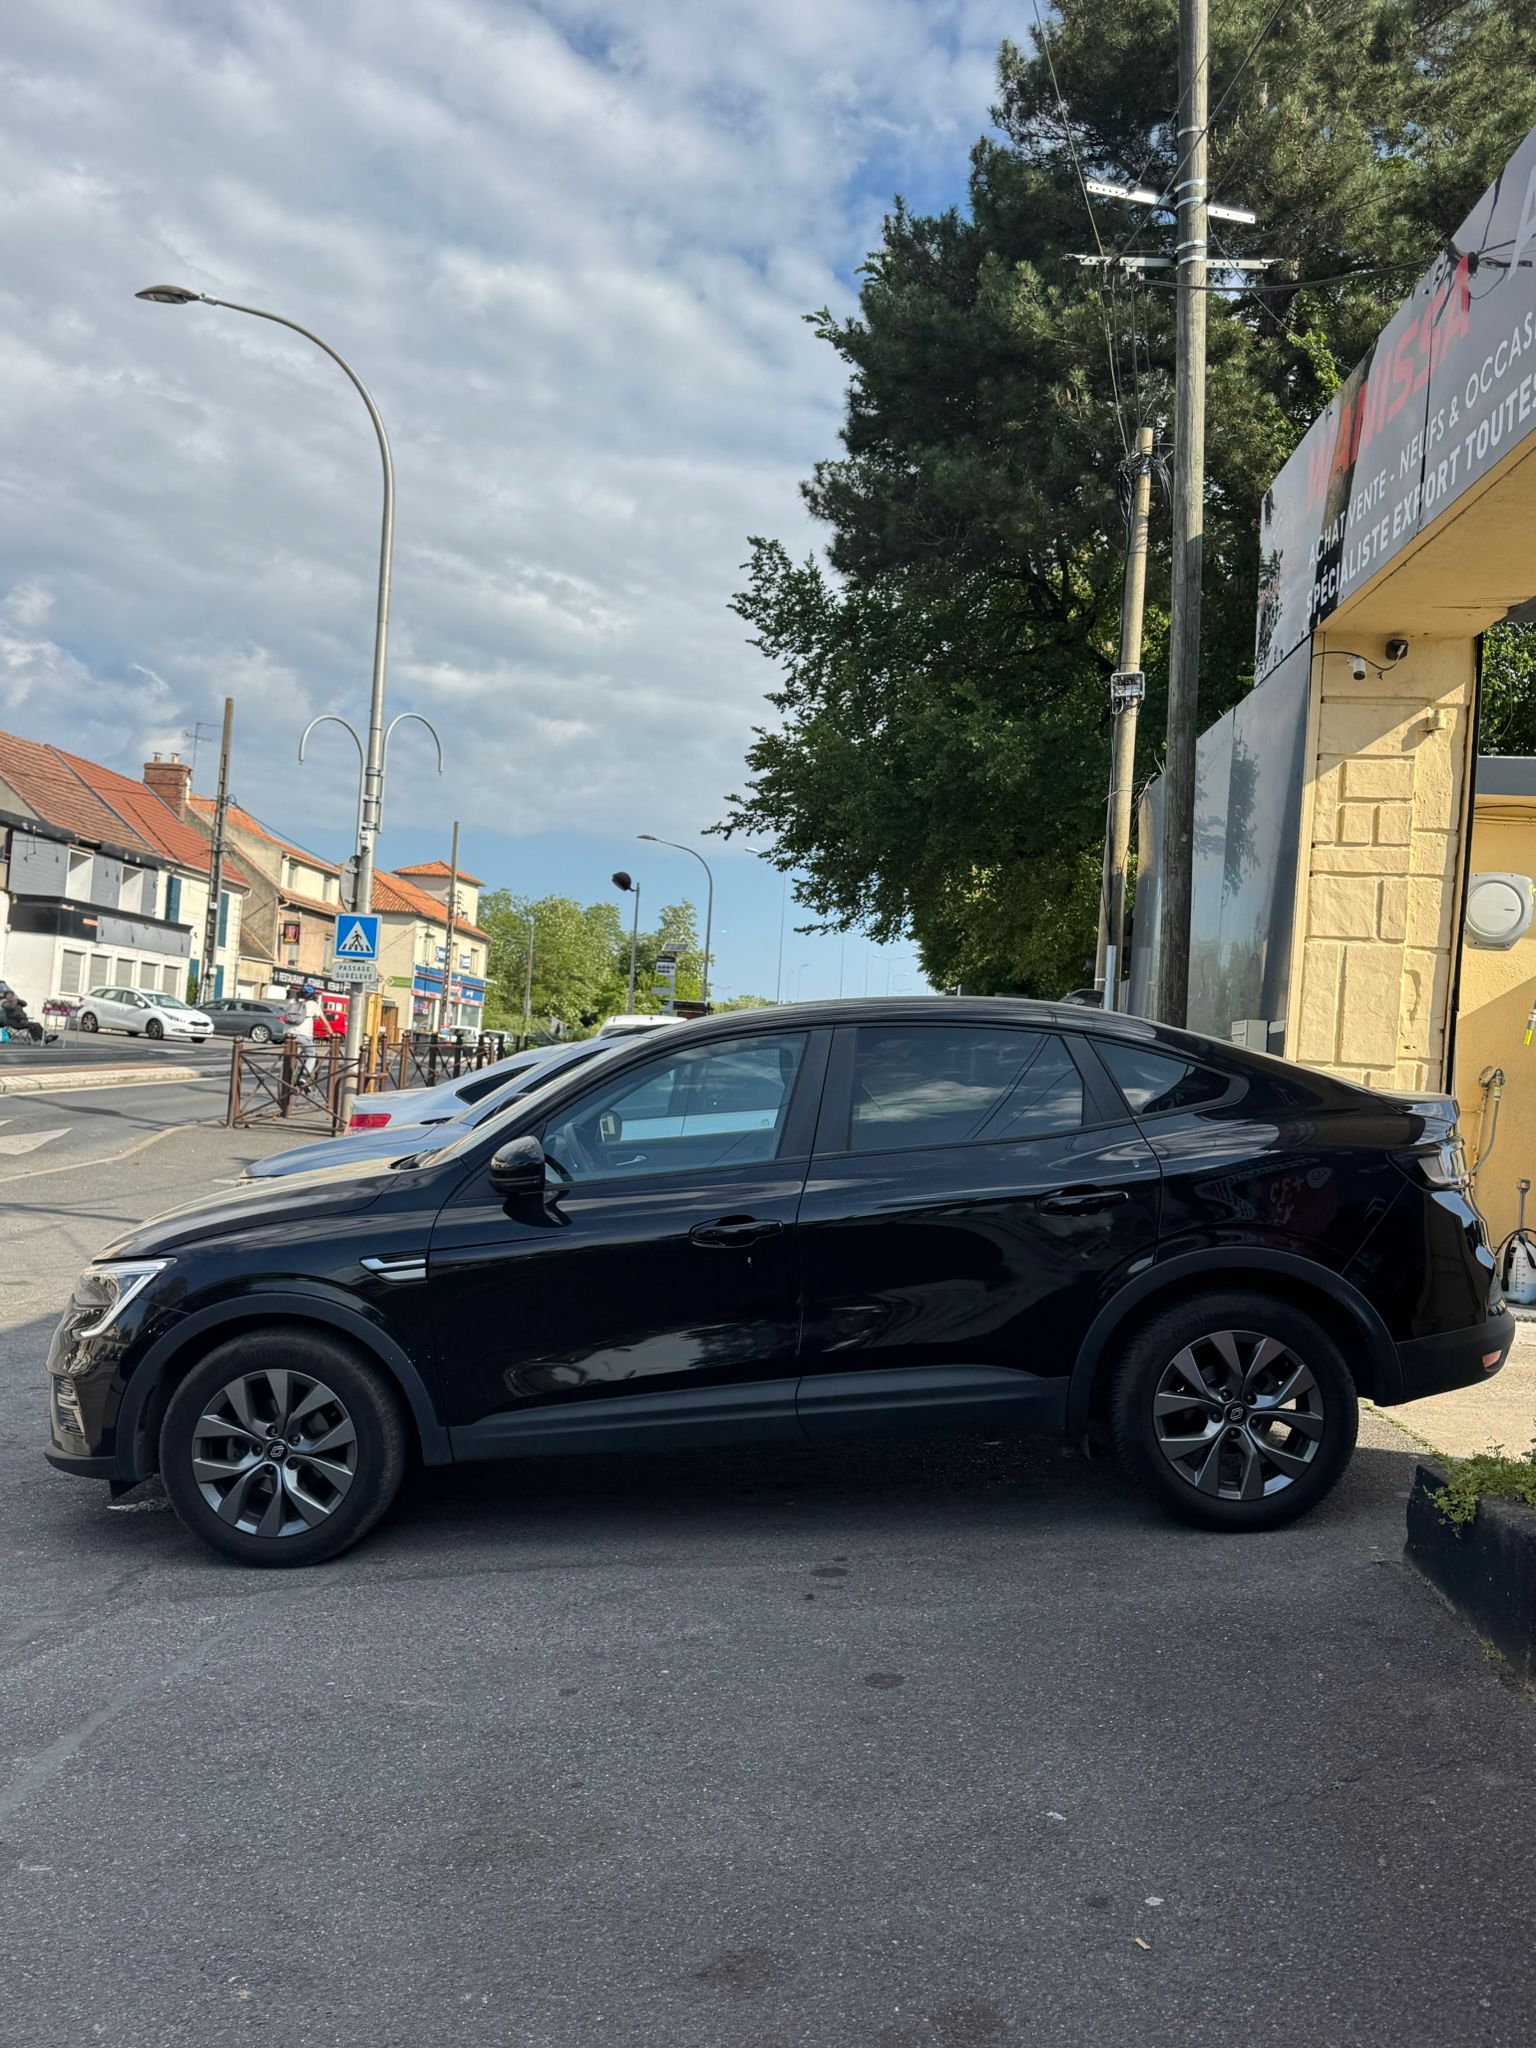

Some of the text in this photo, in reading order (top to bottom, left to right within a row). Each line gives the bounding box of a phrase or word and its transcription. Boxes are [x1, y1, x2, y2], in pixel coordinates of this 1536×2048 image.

[1306, 256, 1470, 509] WANISSA
[1308, 509, 1347, 571] ACHAT
[1347, 469, 1386, 529] VENTE
[1399, 408, 1445, 479] NEUFS
[1449, 395, 1460, 429] &
[1465, 311, 1536, 409] OCCAS
[1305, 513, 1390, 619] SPÉCIALISTE
[1392, 444, 1461, 541] EXPORT
[338, 965, 371, 973] PASSAGE
